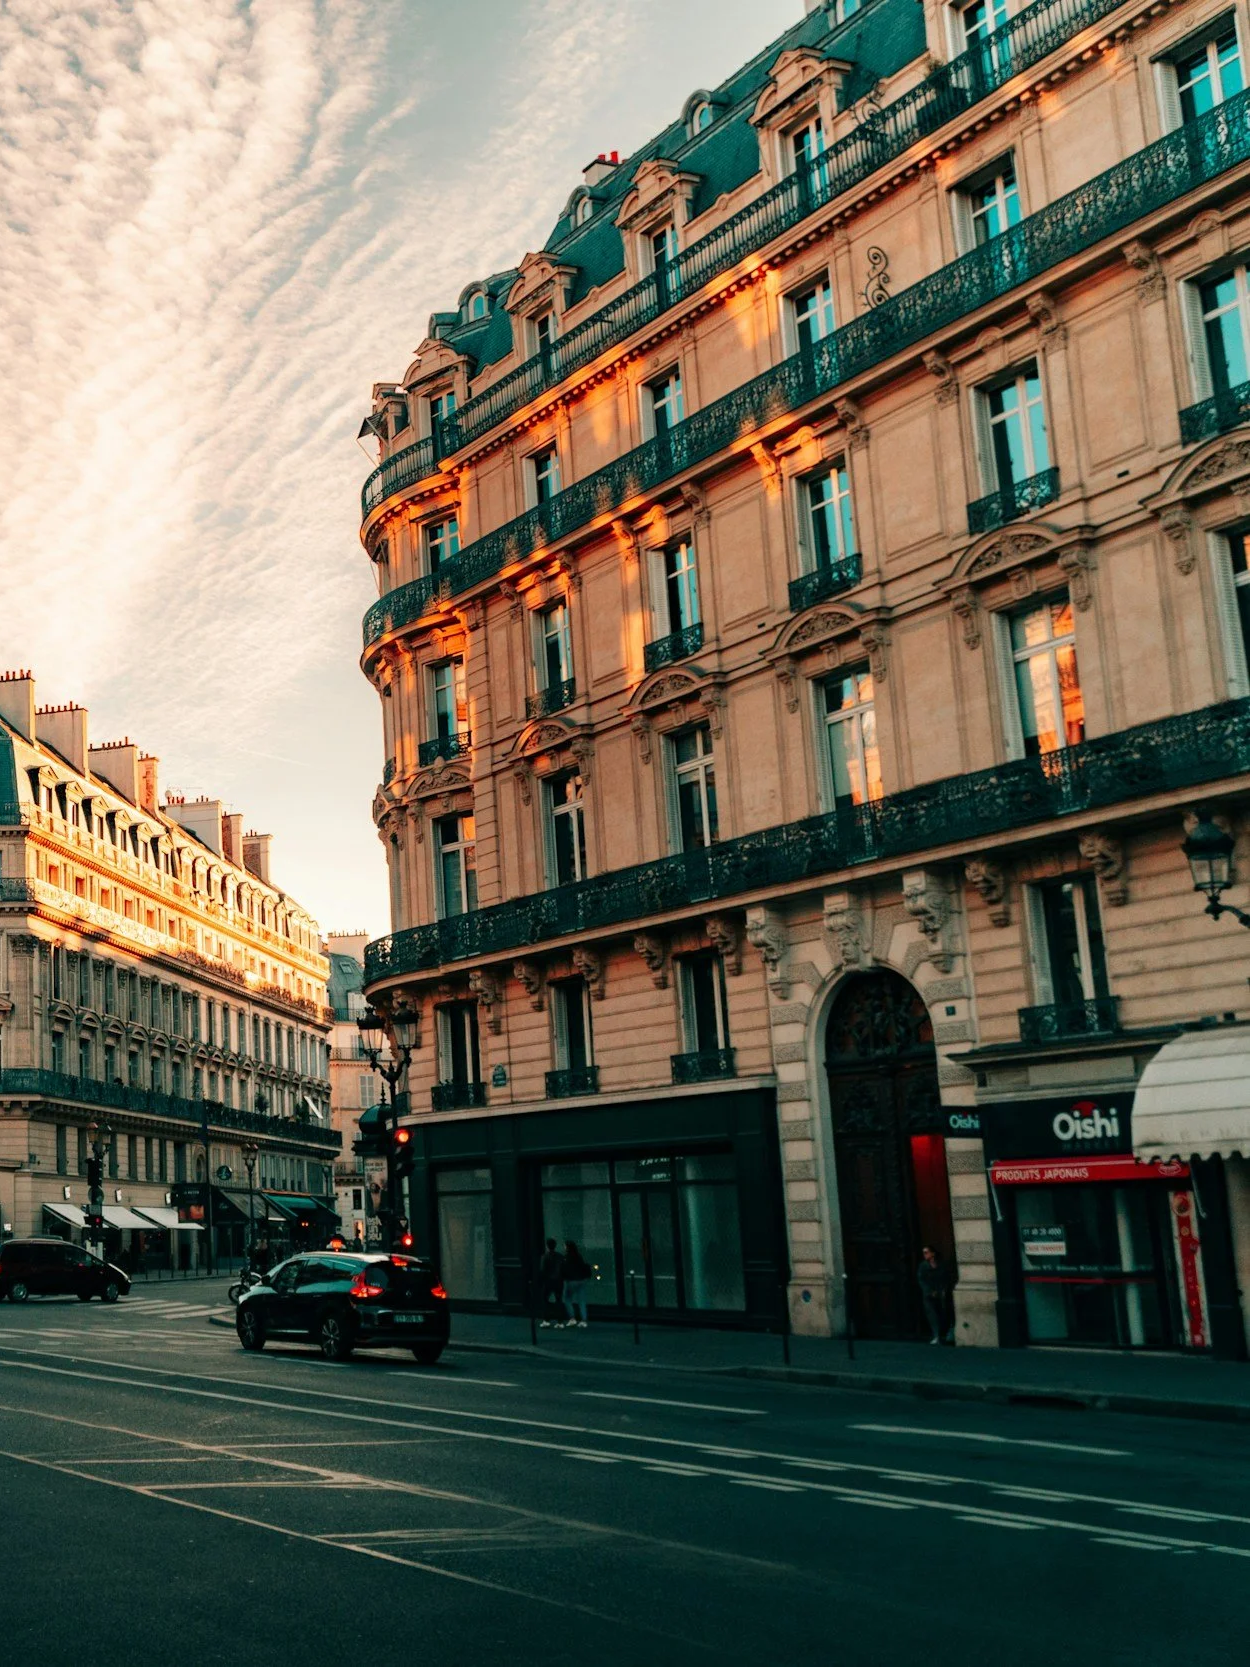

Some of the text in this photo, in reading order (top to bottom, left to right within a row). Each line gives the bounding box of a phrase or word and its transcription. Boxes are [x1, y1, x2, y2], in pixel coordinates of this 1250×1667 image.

[949, 1112, 980, 1129] Oishi
[1052, 1107, 1120, 1141] Oishi
[995, 1167, 1089, 1181] PRODUITS JAPONAIS
